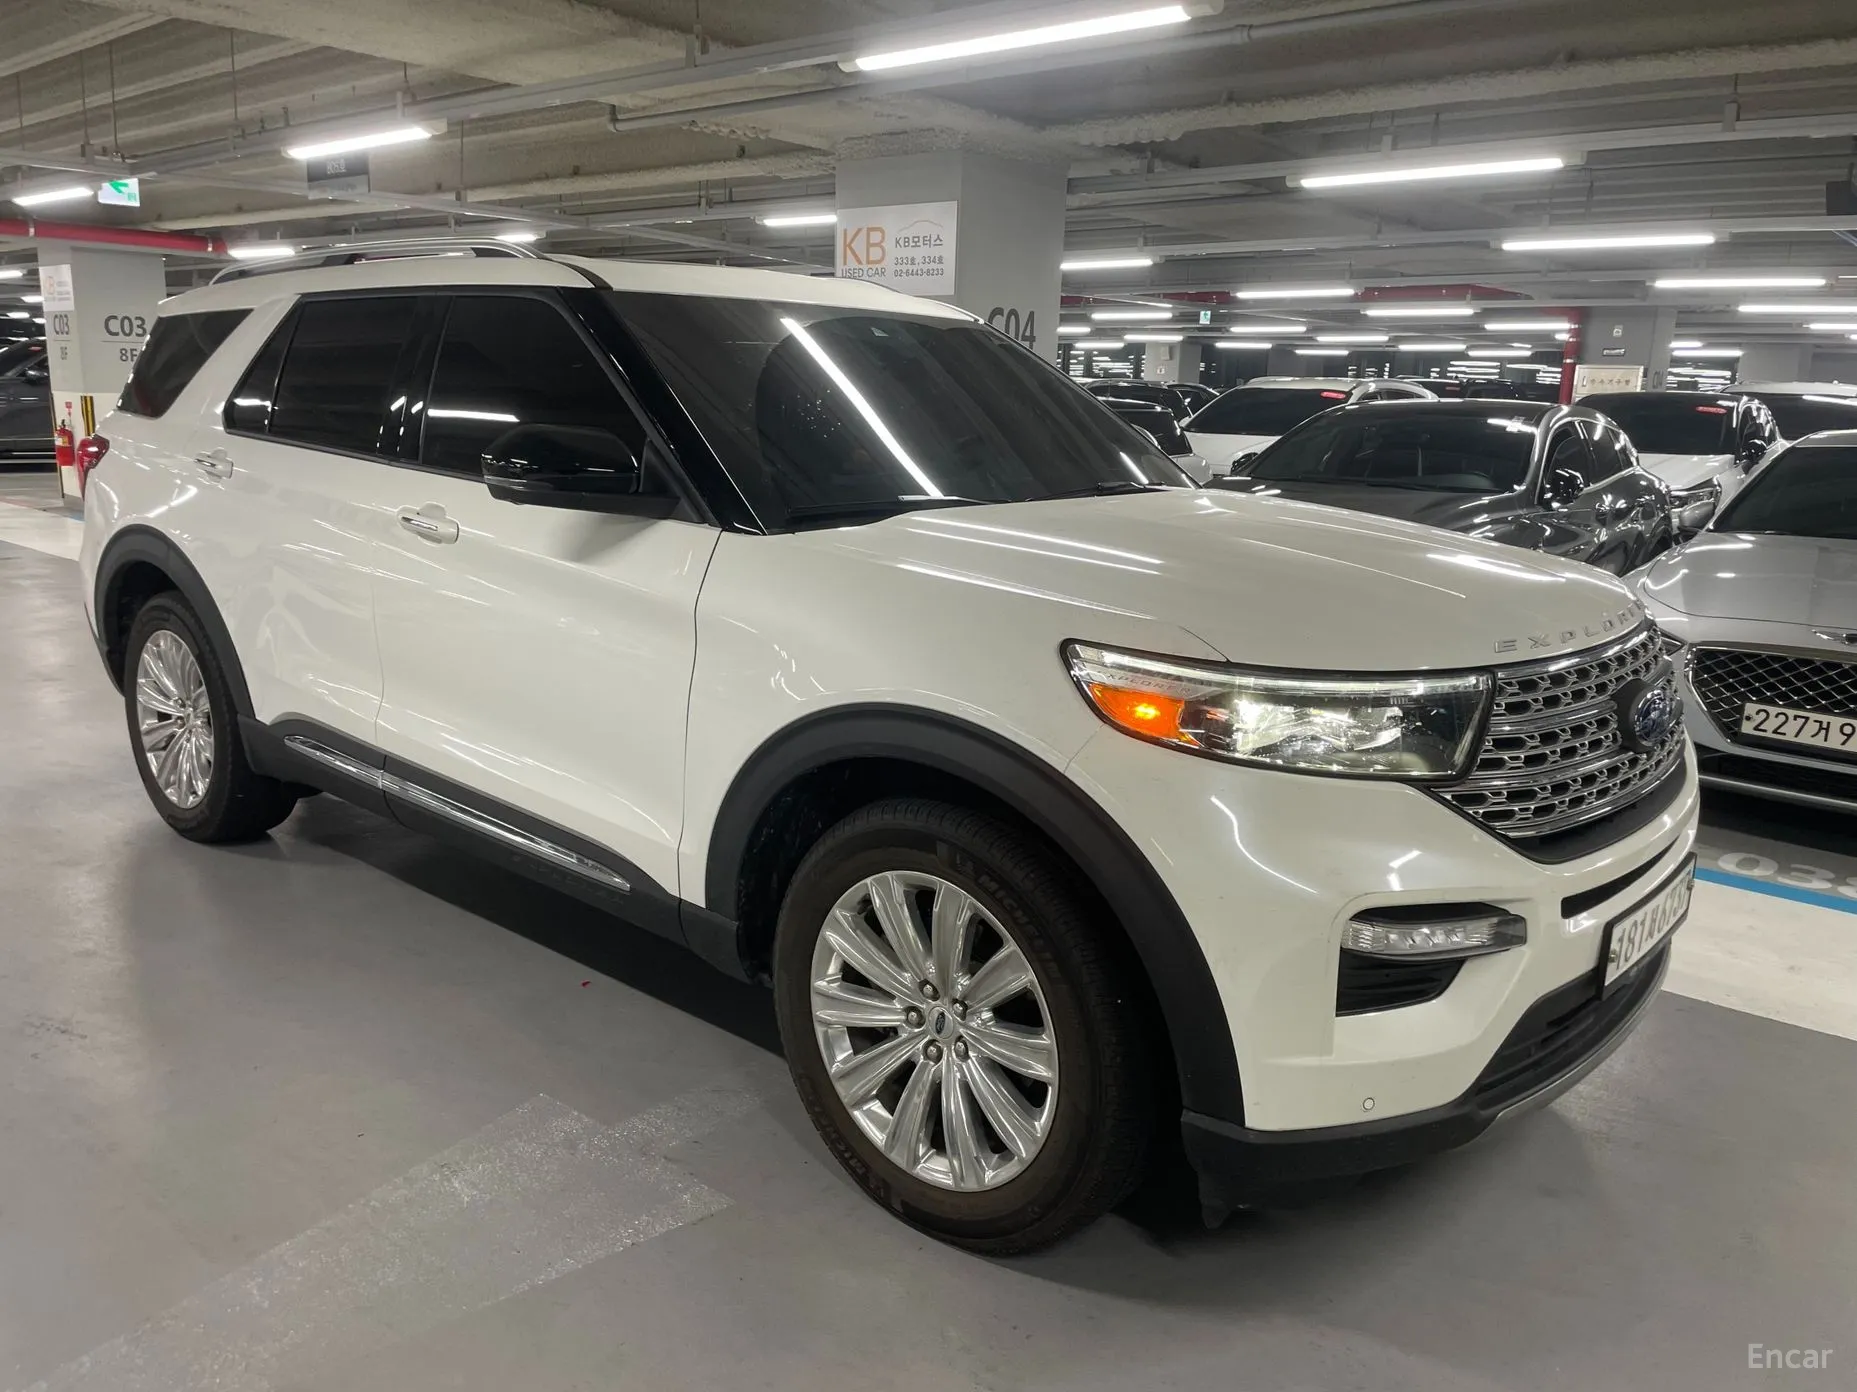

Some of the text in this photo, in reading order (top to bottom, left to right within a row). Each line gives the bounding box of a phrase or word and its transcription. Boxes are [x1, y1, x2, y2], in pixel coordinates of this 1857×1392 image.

[842, 226, 887, 267] KB
[895, 234, 944, 248] KB모터스
[841, 267, 887, 279] USED CAR
[894, 268, 945, 278] 02-6443-8233
[104, 315, 147, 337] C03
[119, 348, 138, 362] 8F
